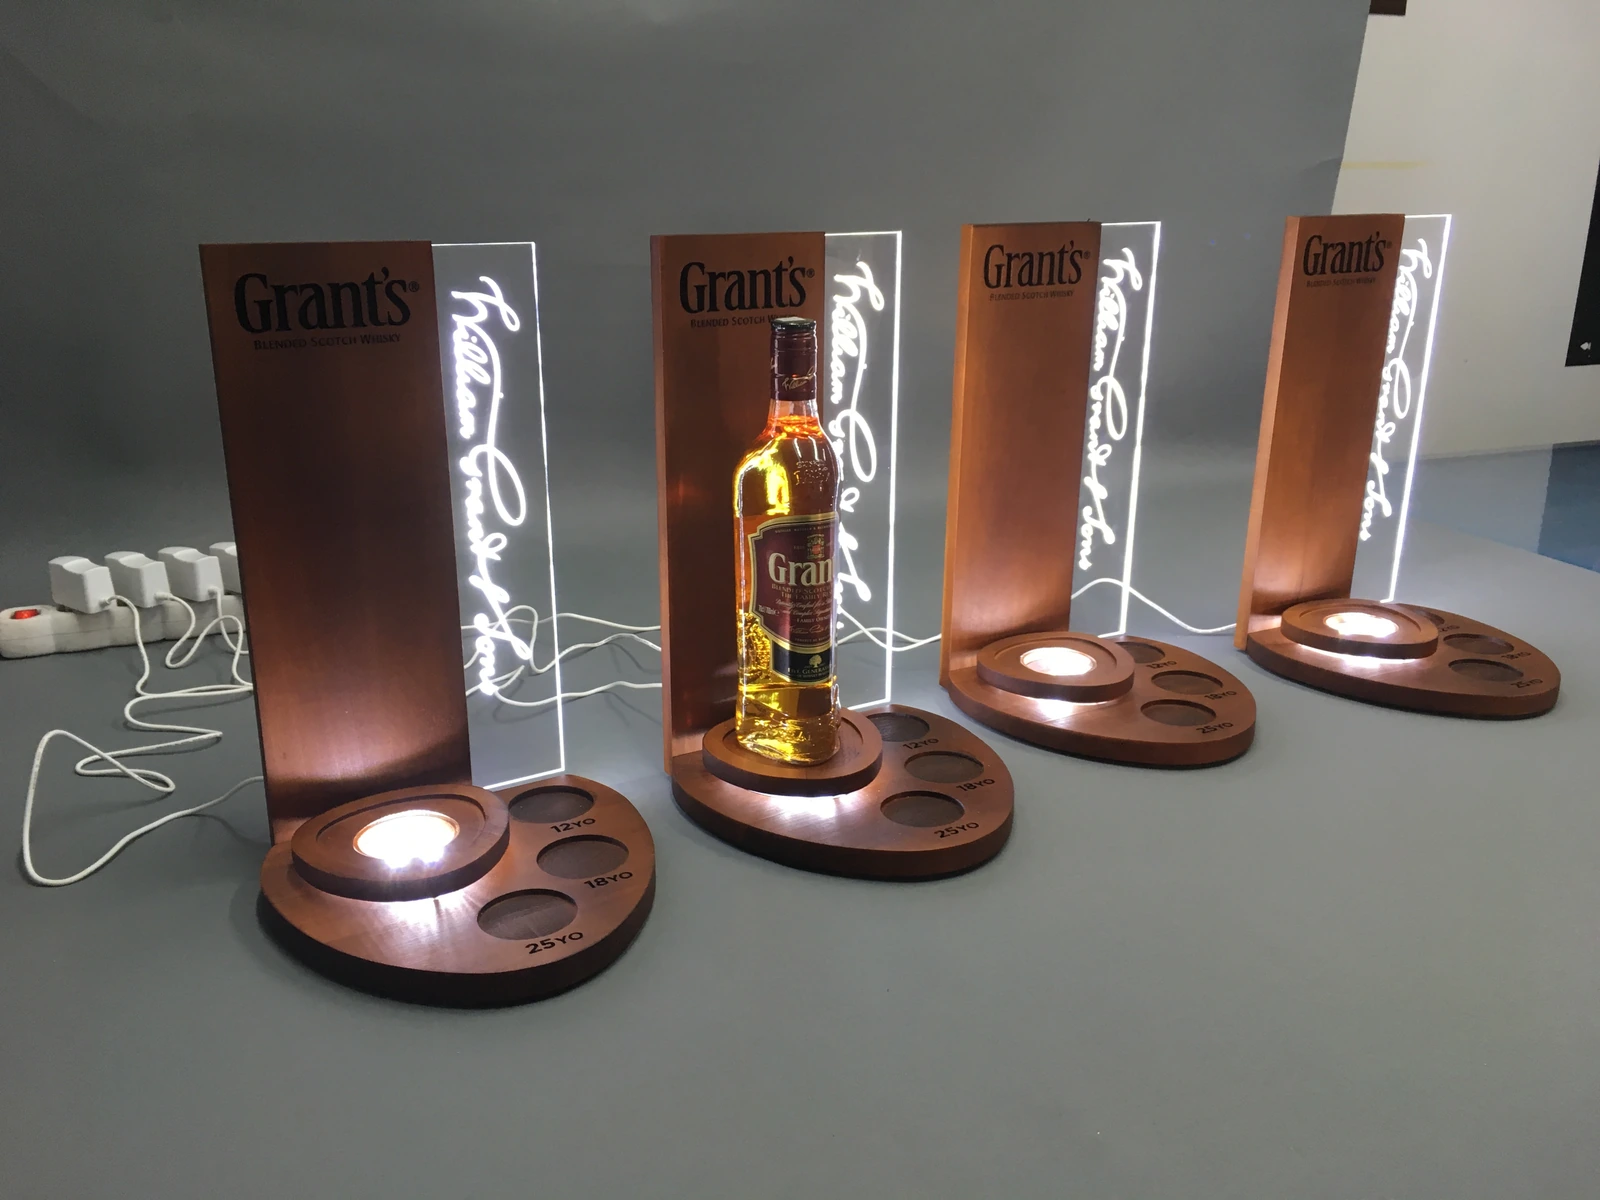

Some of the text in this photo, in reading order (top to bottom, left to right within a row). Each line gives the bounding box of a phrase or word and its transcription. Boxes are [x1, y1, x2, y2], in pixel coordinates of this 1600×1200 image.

[1302, 231, 1386, 276] Grant's
[983, 240, 1083, 289] Grant's
[680, 256, 807, 314] Grant's
[234, 266, 411, 334] Grant's
[690, 318, 729, 328] BLENDED
[731, 316, 766, 326] SCOTCH
[253, 332, 401, 350] BLENDED SCOTCH WHISKY
[1203, 690, 1238, 700] 18YO
[1196, 722, 1235, 734] 25YO
[902, 738, 940, 750] 12YO
[955, 778, 996, 792] 18YO
[550, 818, 597, 833] 12YO
[933, 822, 980, 839] 25YO
[583, 871, 634, 889] 18YO
[525, 932, 584, 955] 25YO
